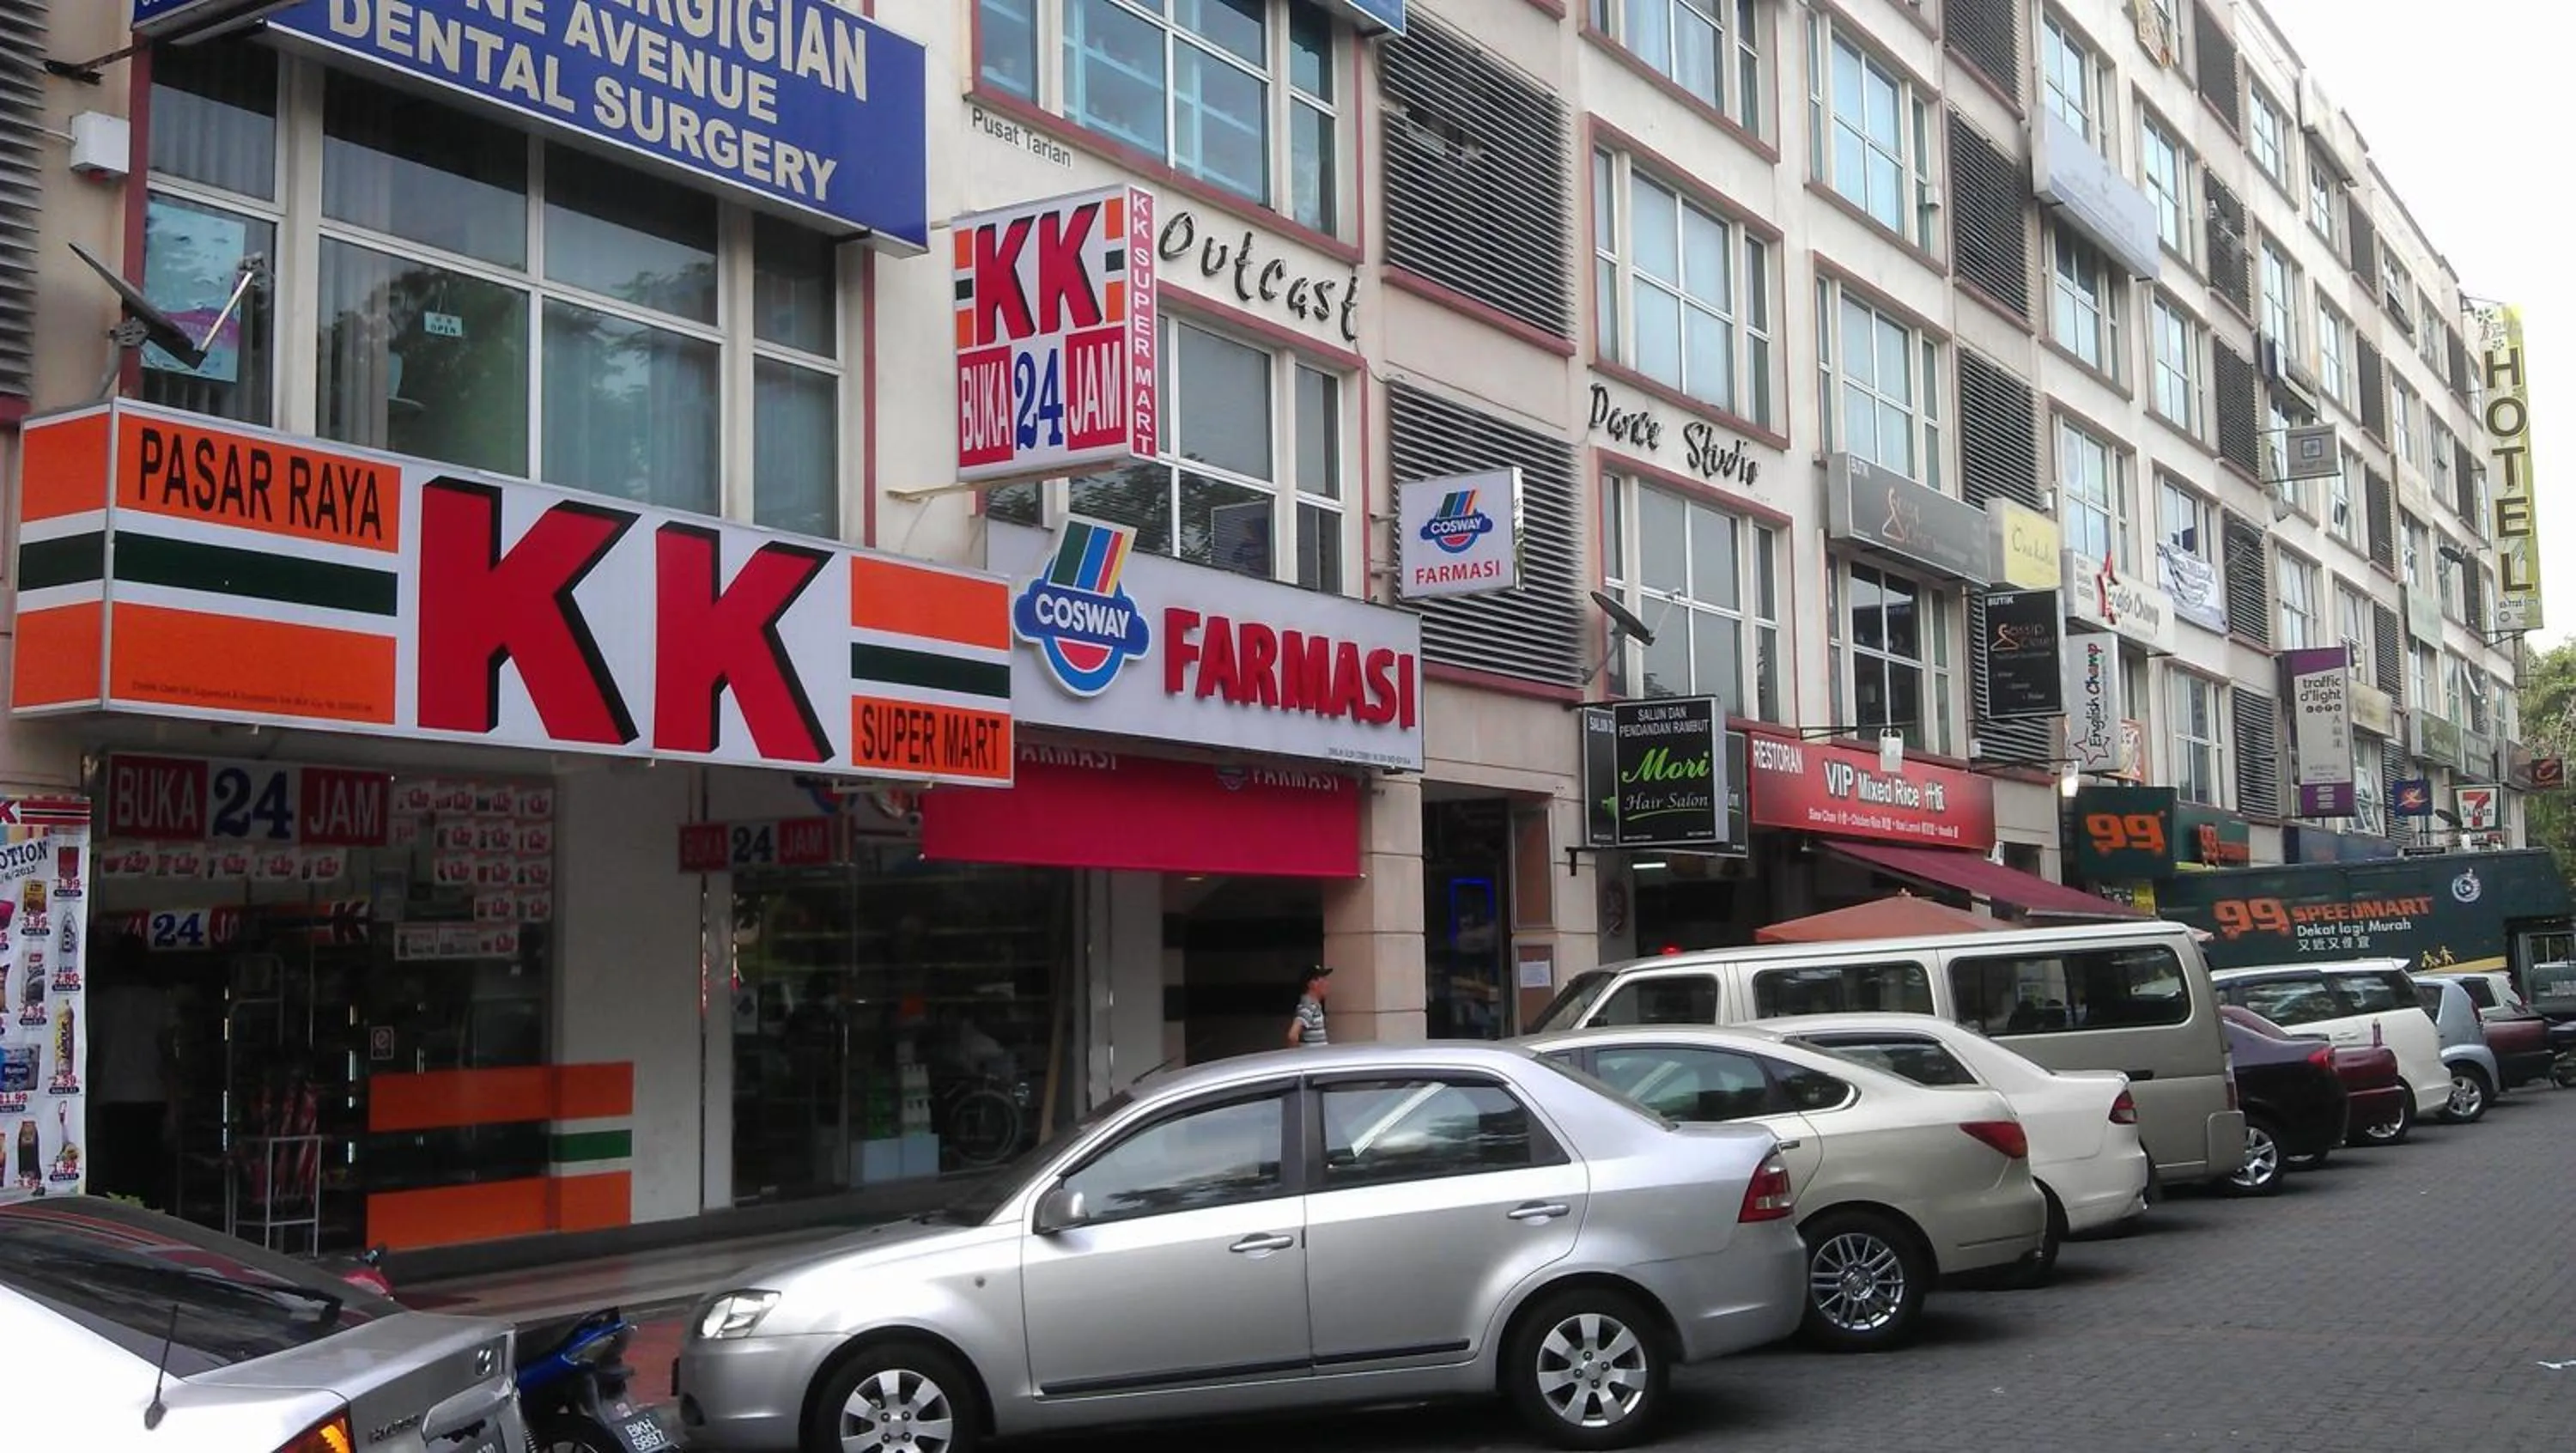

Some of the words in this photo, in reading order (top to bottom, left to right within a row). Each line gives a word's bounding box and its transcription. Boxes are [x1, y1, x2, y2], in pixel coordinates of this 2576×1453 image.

[563, 0, 777, 124] AVENUE
[613, 0, 866, 102] GIGIAN
[329, 0, 574, 113] DENTAL
[593, 76, 837, 202] SURGERY
[971, 106, 1019, 146] Pusat
[1023, 128, 1071, 167] Tarian
[975, 202, 1103, 346] KK
[1158, 211, 1359, 342] Outcast
[1133, 246, 1151, 358] SUPER
[963, 361, 1011, 453] BUKA
[1014, 348, 1064, 451] 24
[1070, 341, 1121, 436] JAM
[1135, 368, 1152, 454] MART
[1589, 383, 1662, 451] Dance
[1683, 422, 1759, 486] Studio
[139, 427, 273, 522] PASAR
[289, 456, 383, 540] RAYA
[2484, 346, 2533, 593] HOTEL
[1431, 517, 1482, 533] COSWAY
[1415, 560, 1501, 585] FARMASI
[417, 475, 835, 763] KK
[1035, 593, 1132, 640] COSWAY
[1164, 607, 1416, 730] FARMASI
[2302, 675, 2342, 689] traffic
[1668, 706, 1687, 719] DAN
[861, 703, 936, 765] SUPER
[944, 712, 1000, 772] MART
[1016, 744, 1116, 771] ARMASI
[1753, 739, 1803, 774] RESTORAN
[1621, 745, 1710, 783] Mori
[1824, 760, 1854, 796] VIP
[1857, 772, 1892, 804] Mixed
[1894, 779, 1920, 808] Rice
[117, 767, 198, 830] BUKA
[213, 768, 294, 839] 24
[309, 777, 380, 838] JAM
[1625, 792, 1663, 812] Hair
[1667, 791, 1709, 809] Salon
[2463, 792, 2490, 826] 7
[732, 826, 772, 863] 24
[2087, 814, 2165, 854] 99
[153, 913, 204, 948] 24
[2214, 897, 2290, 939] 99
[2292, 897, 2433, 923] SPEEDMART
[2297, 923, 2336, 938] Dekat
[2338, 921, 2364, 936] lagi
[2368, 918, 2412, 933] Murah
[625, 1417, 656, 1438] BKH
